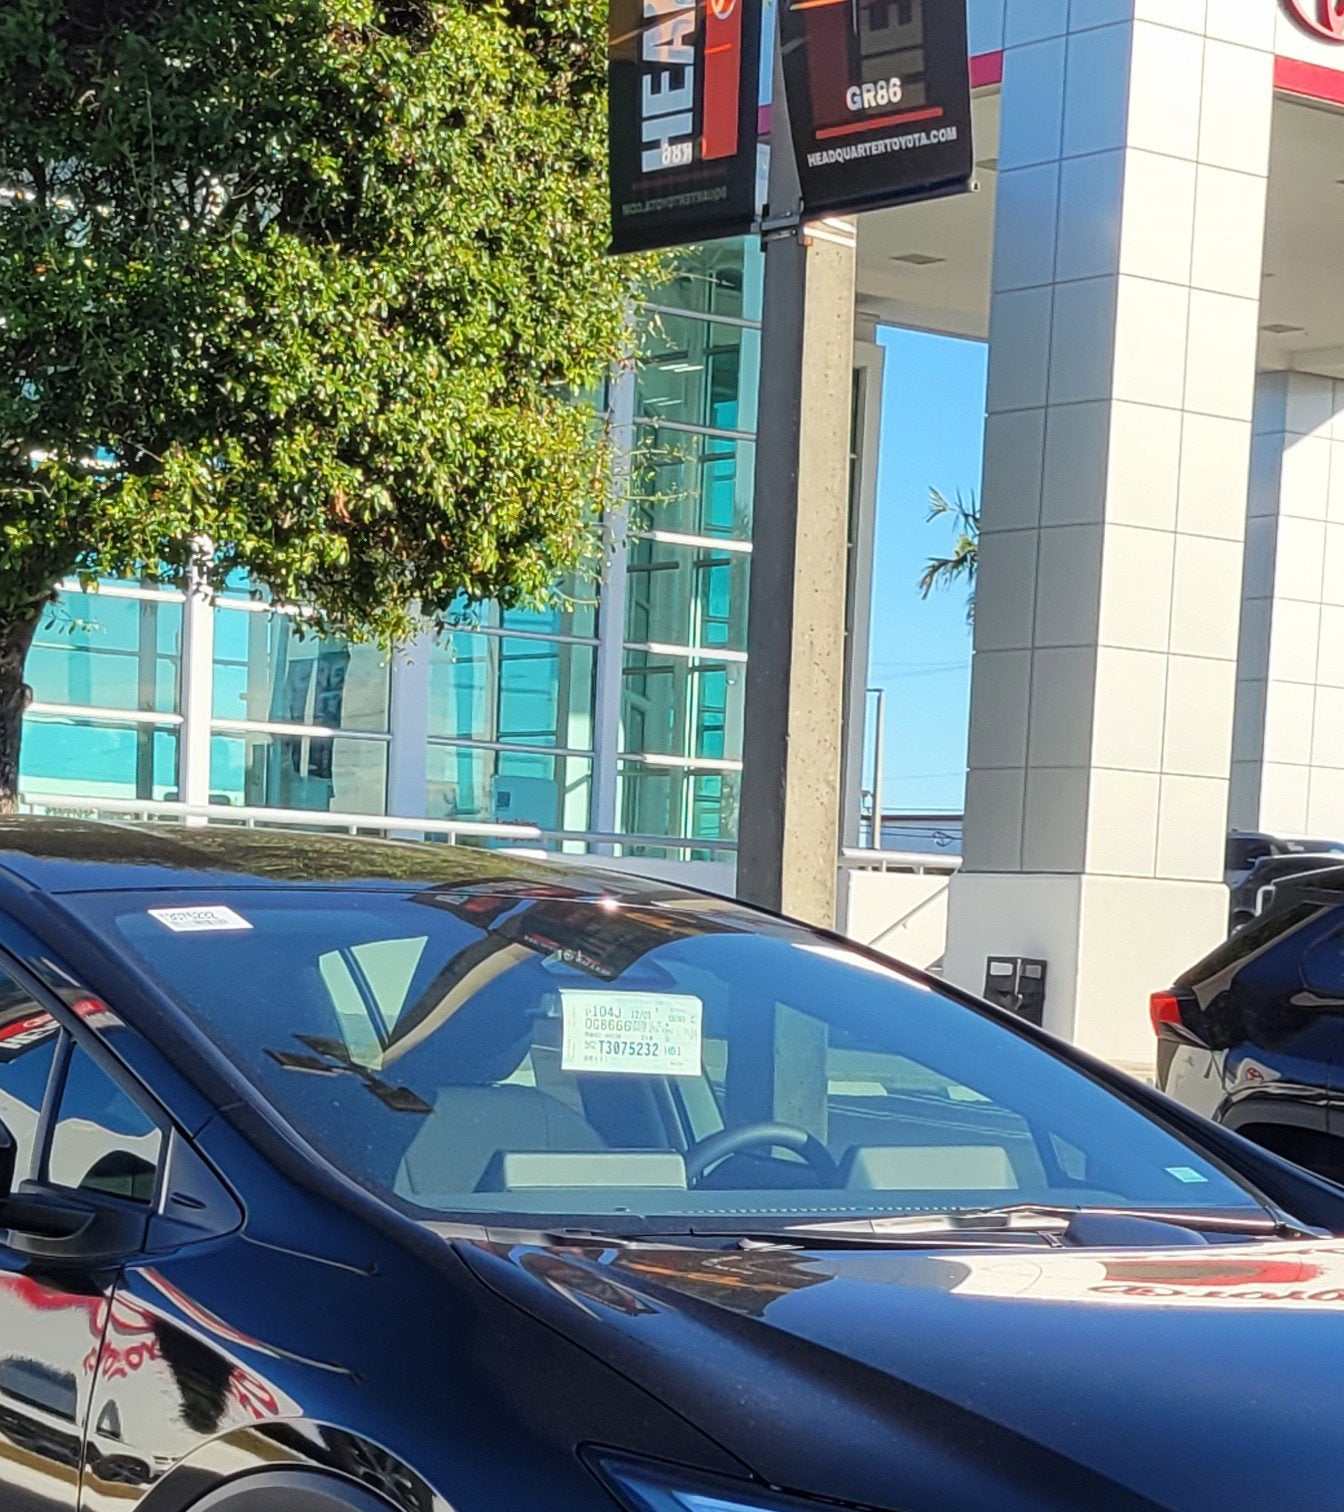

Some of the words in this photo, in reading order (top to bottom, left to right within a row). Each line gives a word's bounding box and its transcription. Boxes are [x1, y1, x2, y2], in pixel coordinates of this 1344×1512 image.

[846, 77, 903, 111] GR86
[807, 126, 958, 168] HEADQUARTERTOYOTA.COM
[599, 1040, 659, 1057] T3075232
